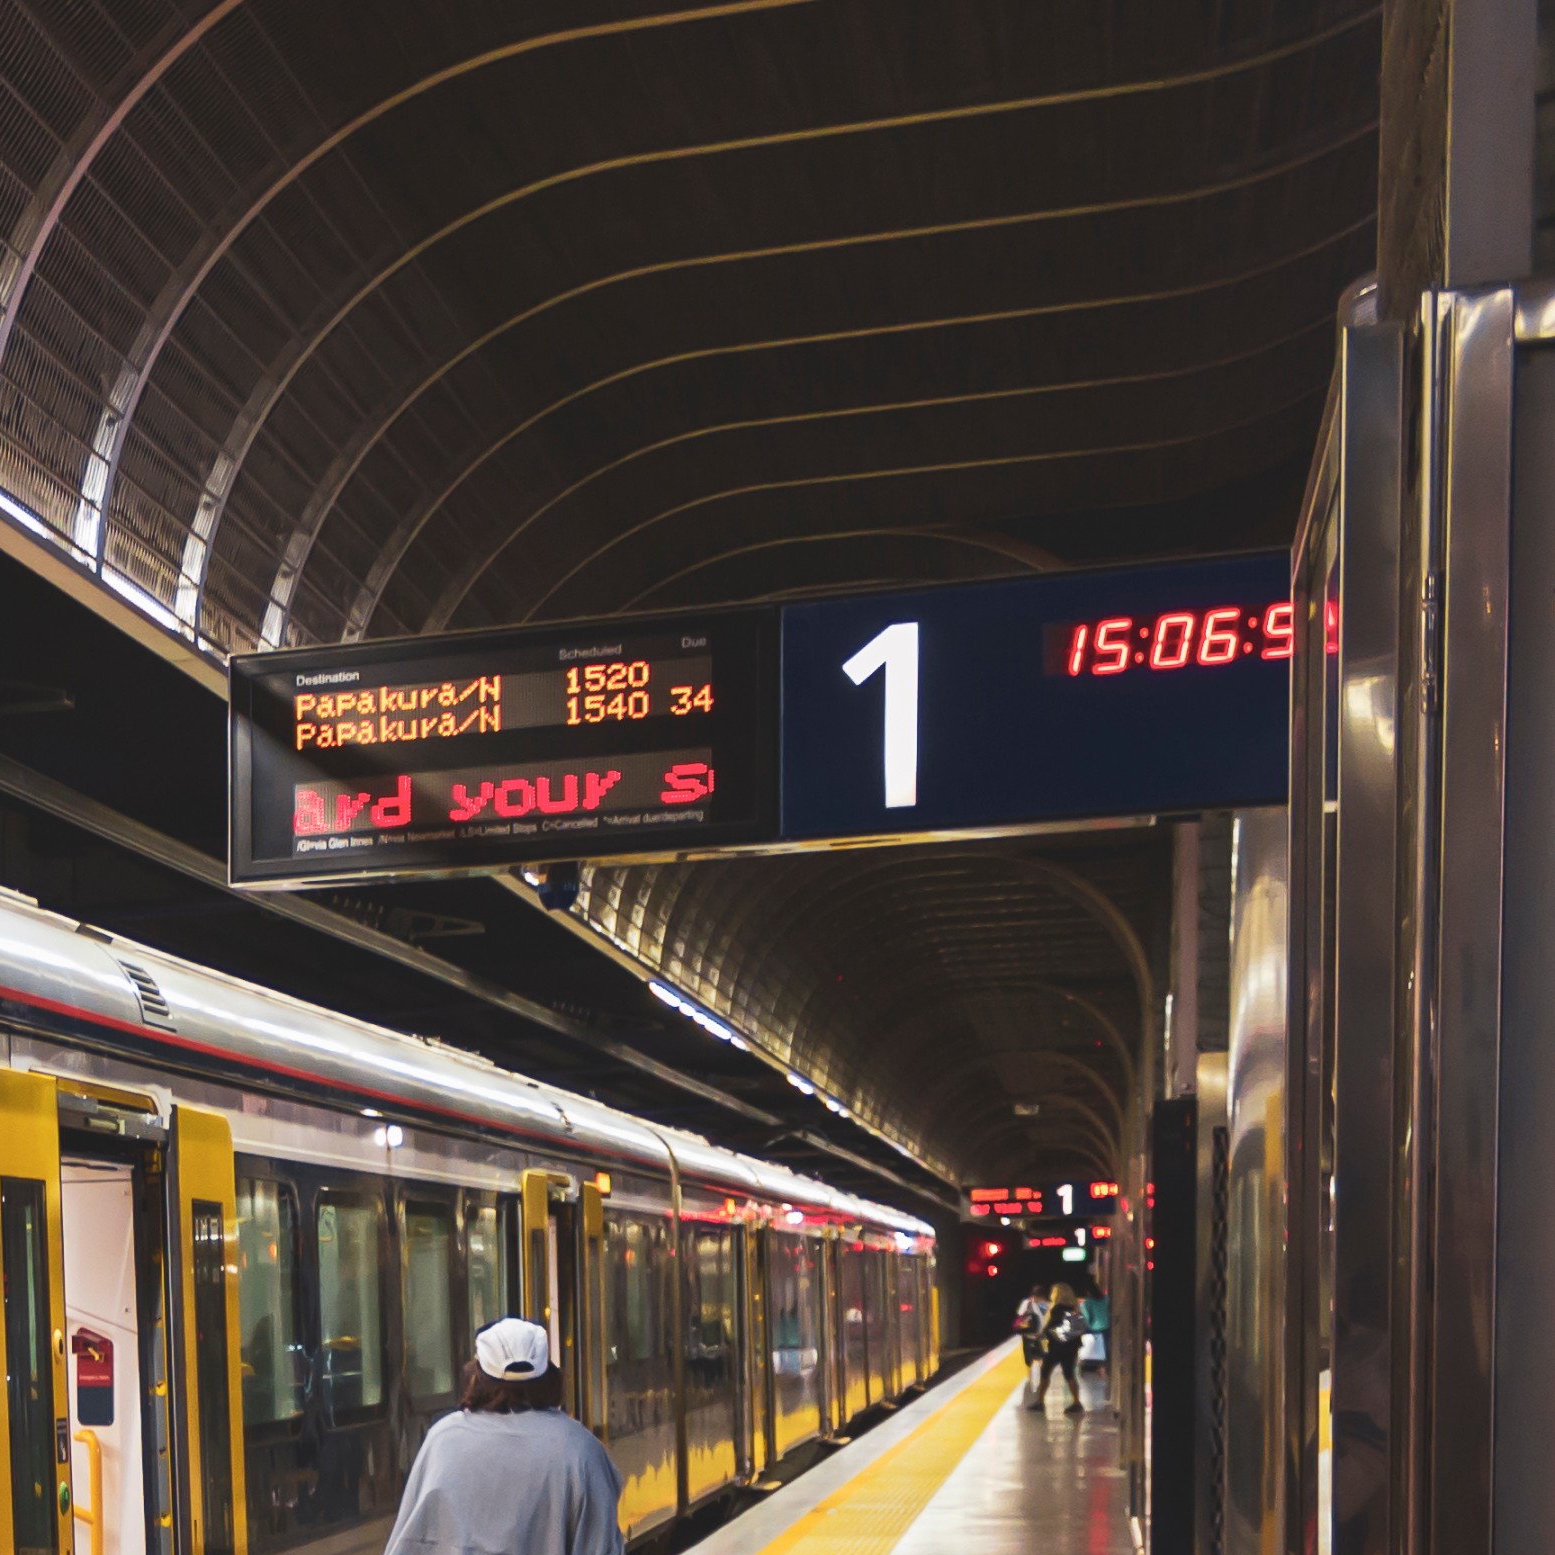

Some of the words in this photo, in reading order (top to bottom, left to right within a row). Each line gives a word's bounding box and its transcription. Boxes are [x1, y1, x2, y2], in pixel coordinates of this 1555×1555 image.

[296, 671, 360, 687] Destination
[558, 644, 622, 661] Scheduled
[681, 636, 707, 648] Due
[1067, 603, 1340, 676] 15:06:5
[566, 661, 650, 694] 1520
[566, 690, 650, 725] 1540
[670, 684, 714, 715] 34
[842, 621, 919, 808] 1
[449, 770, 621, 821] your
[1057, 1184, 1072, 1215] 1
[1074, 1228, 1086, 1246] 1
